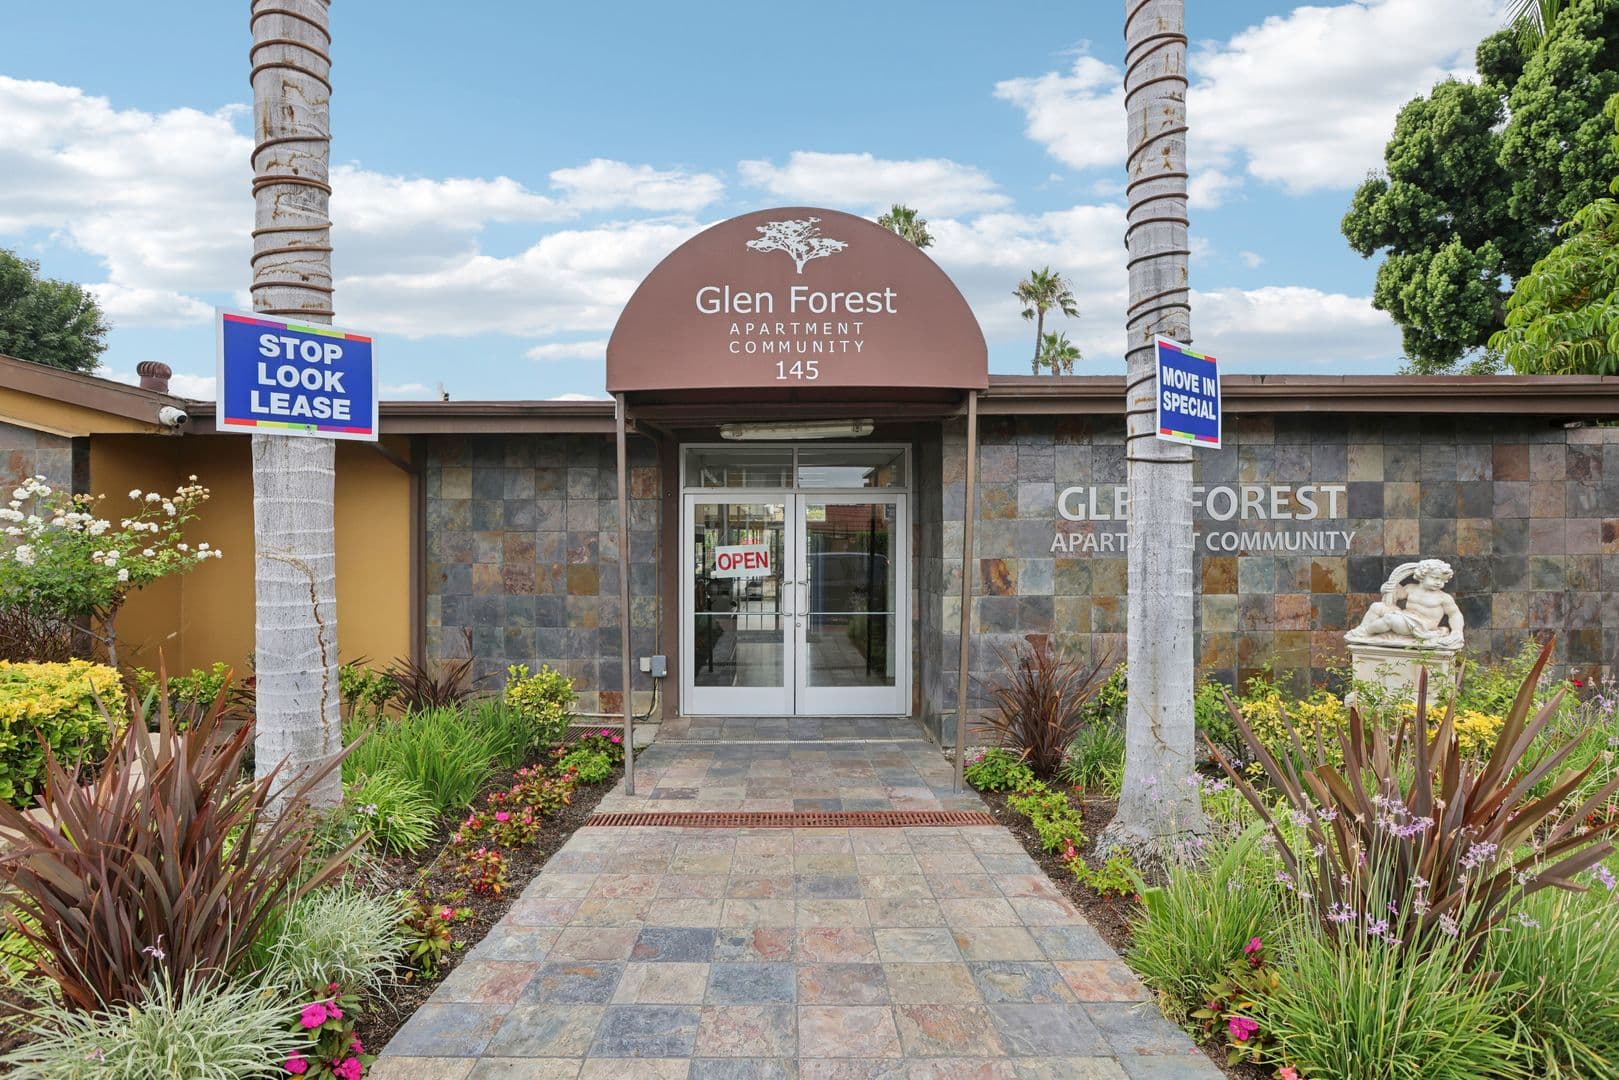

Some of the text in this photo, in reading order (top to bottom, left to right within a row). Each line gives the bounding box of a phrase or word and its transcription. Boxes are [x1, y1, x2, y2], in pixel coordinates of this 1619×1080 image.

[695, 285, 898, 315] Glen Forest
[729, 322, 864, 336] APARTMENT
[258, 333, 344, 365] STOP
[729, 340, 866, 354] COMMUNITY
[257, 361, 347, 394] LOOK
[775, 360, 820, 381] 145
[1162, 365, 1216, 398] MOVE IN
[250, 389, 351, 421] LEASE
[1162, 390, 1217, 421] SPECIAL
[1057, 486, 1129, 522] GLE
[1049, 531, 1356, 553] APARTT COMMUNITY
[717, 551, 769, 571] OPEN
